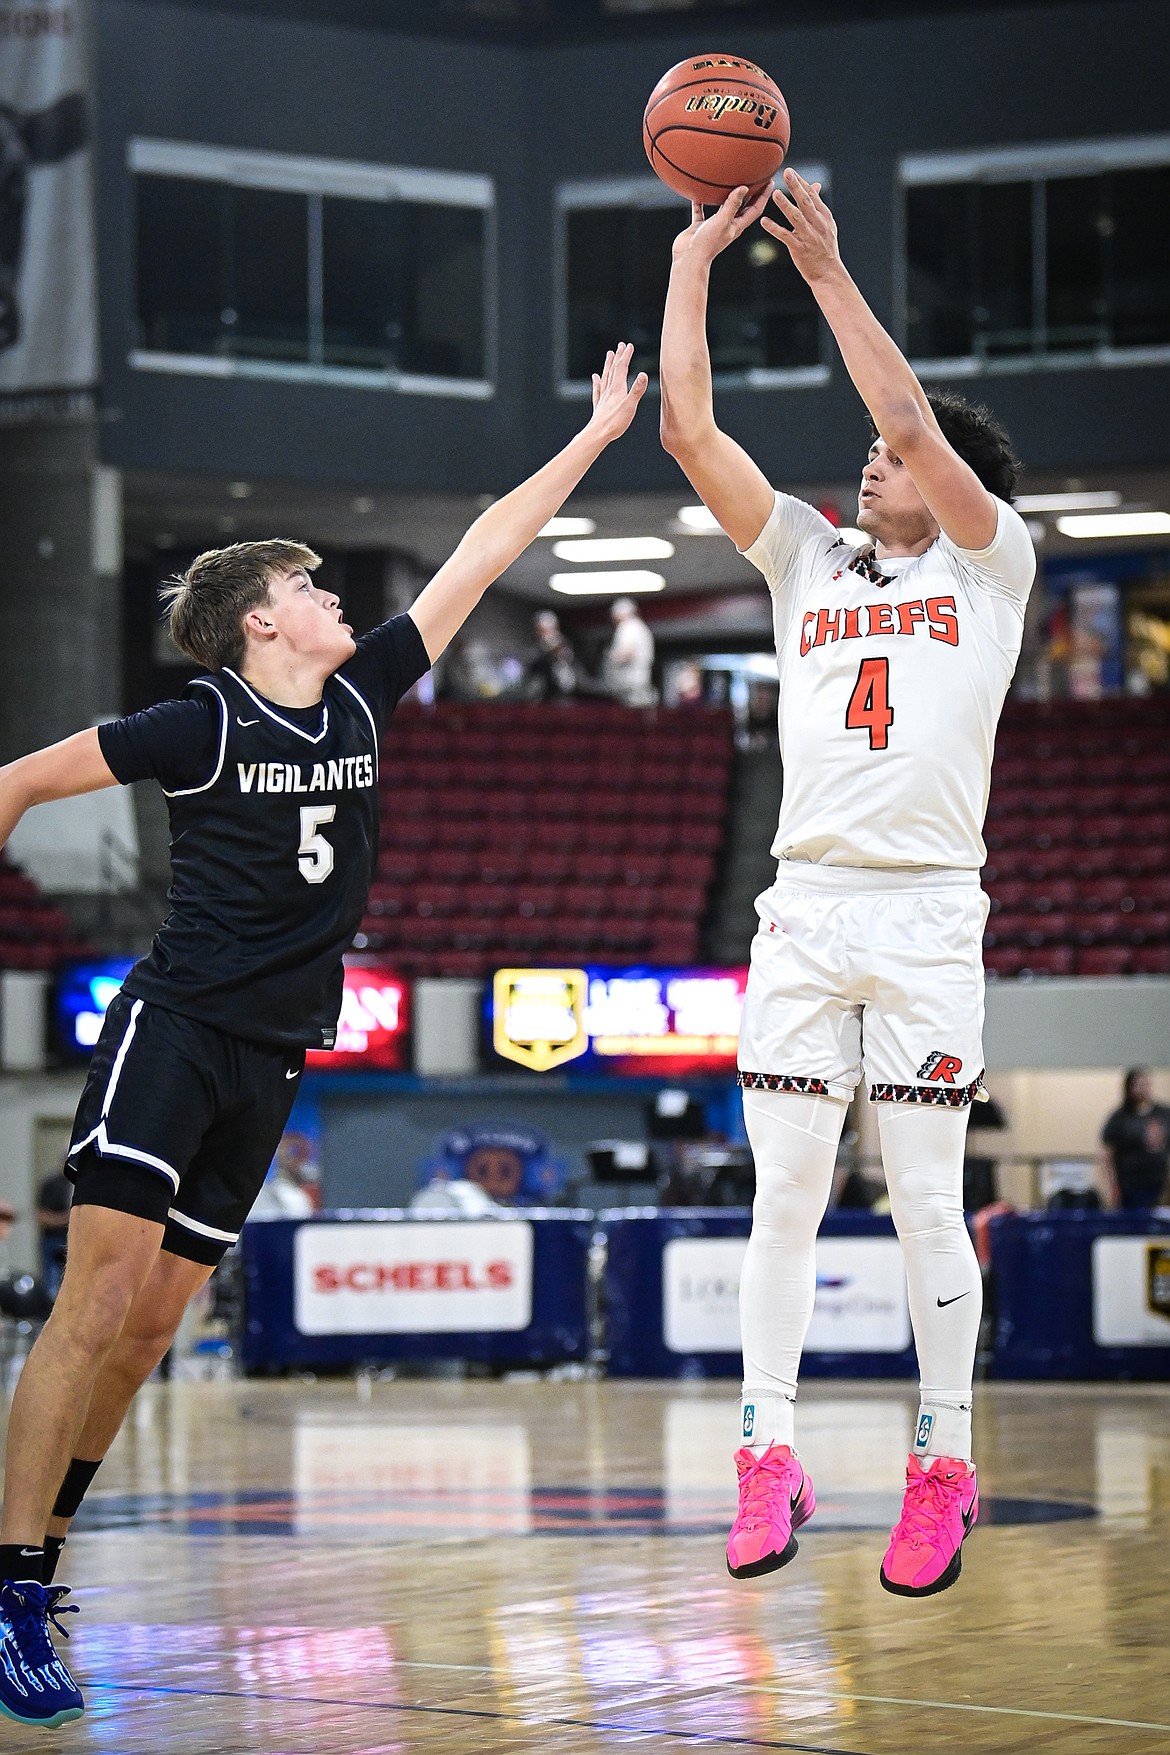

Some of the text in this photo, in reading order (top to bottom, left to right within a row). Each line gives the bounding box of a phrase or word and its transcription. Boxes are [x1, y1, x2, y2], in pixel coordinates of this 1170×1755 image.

[684, 94, 779, 130] Baden
[799, 596, 959, 658] CHIEFS
[845, 656, 894, 751] 4
[236, 753, 374, 794] VIGILANTES
[297, 804, 337, 884] 5
[313, 1258, 515, 1294] SCHEELS
